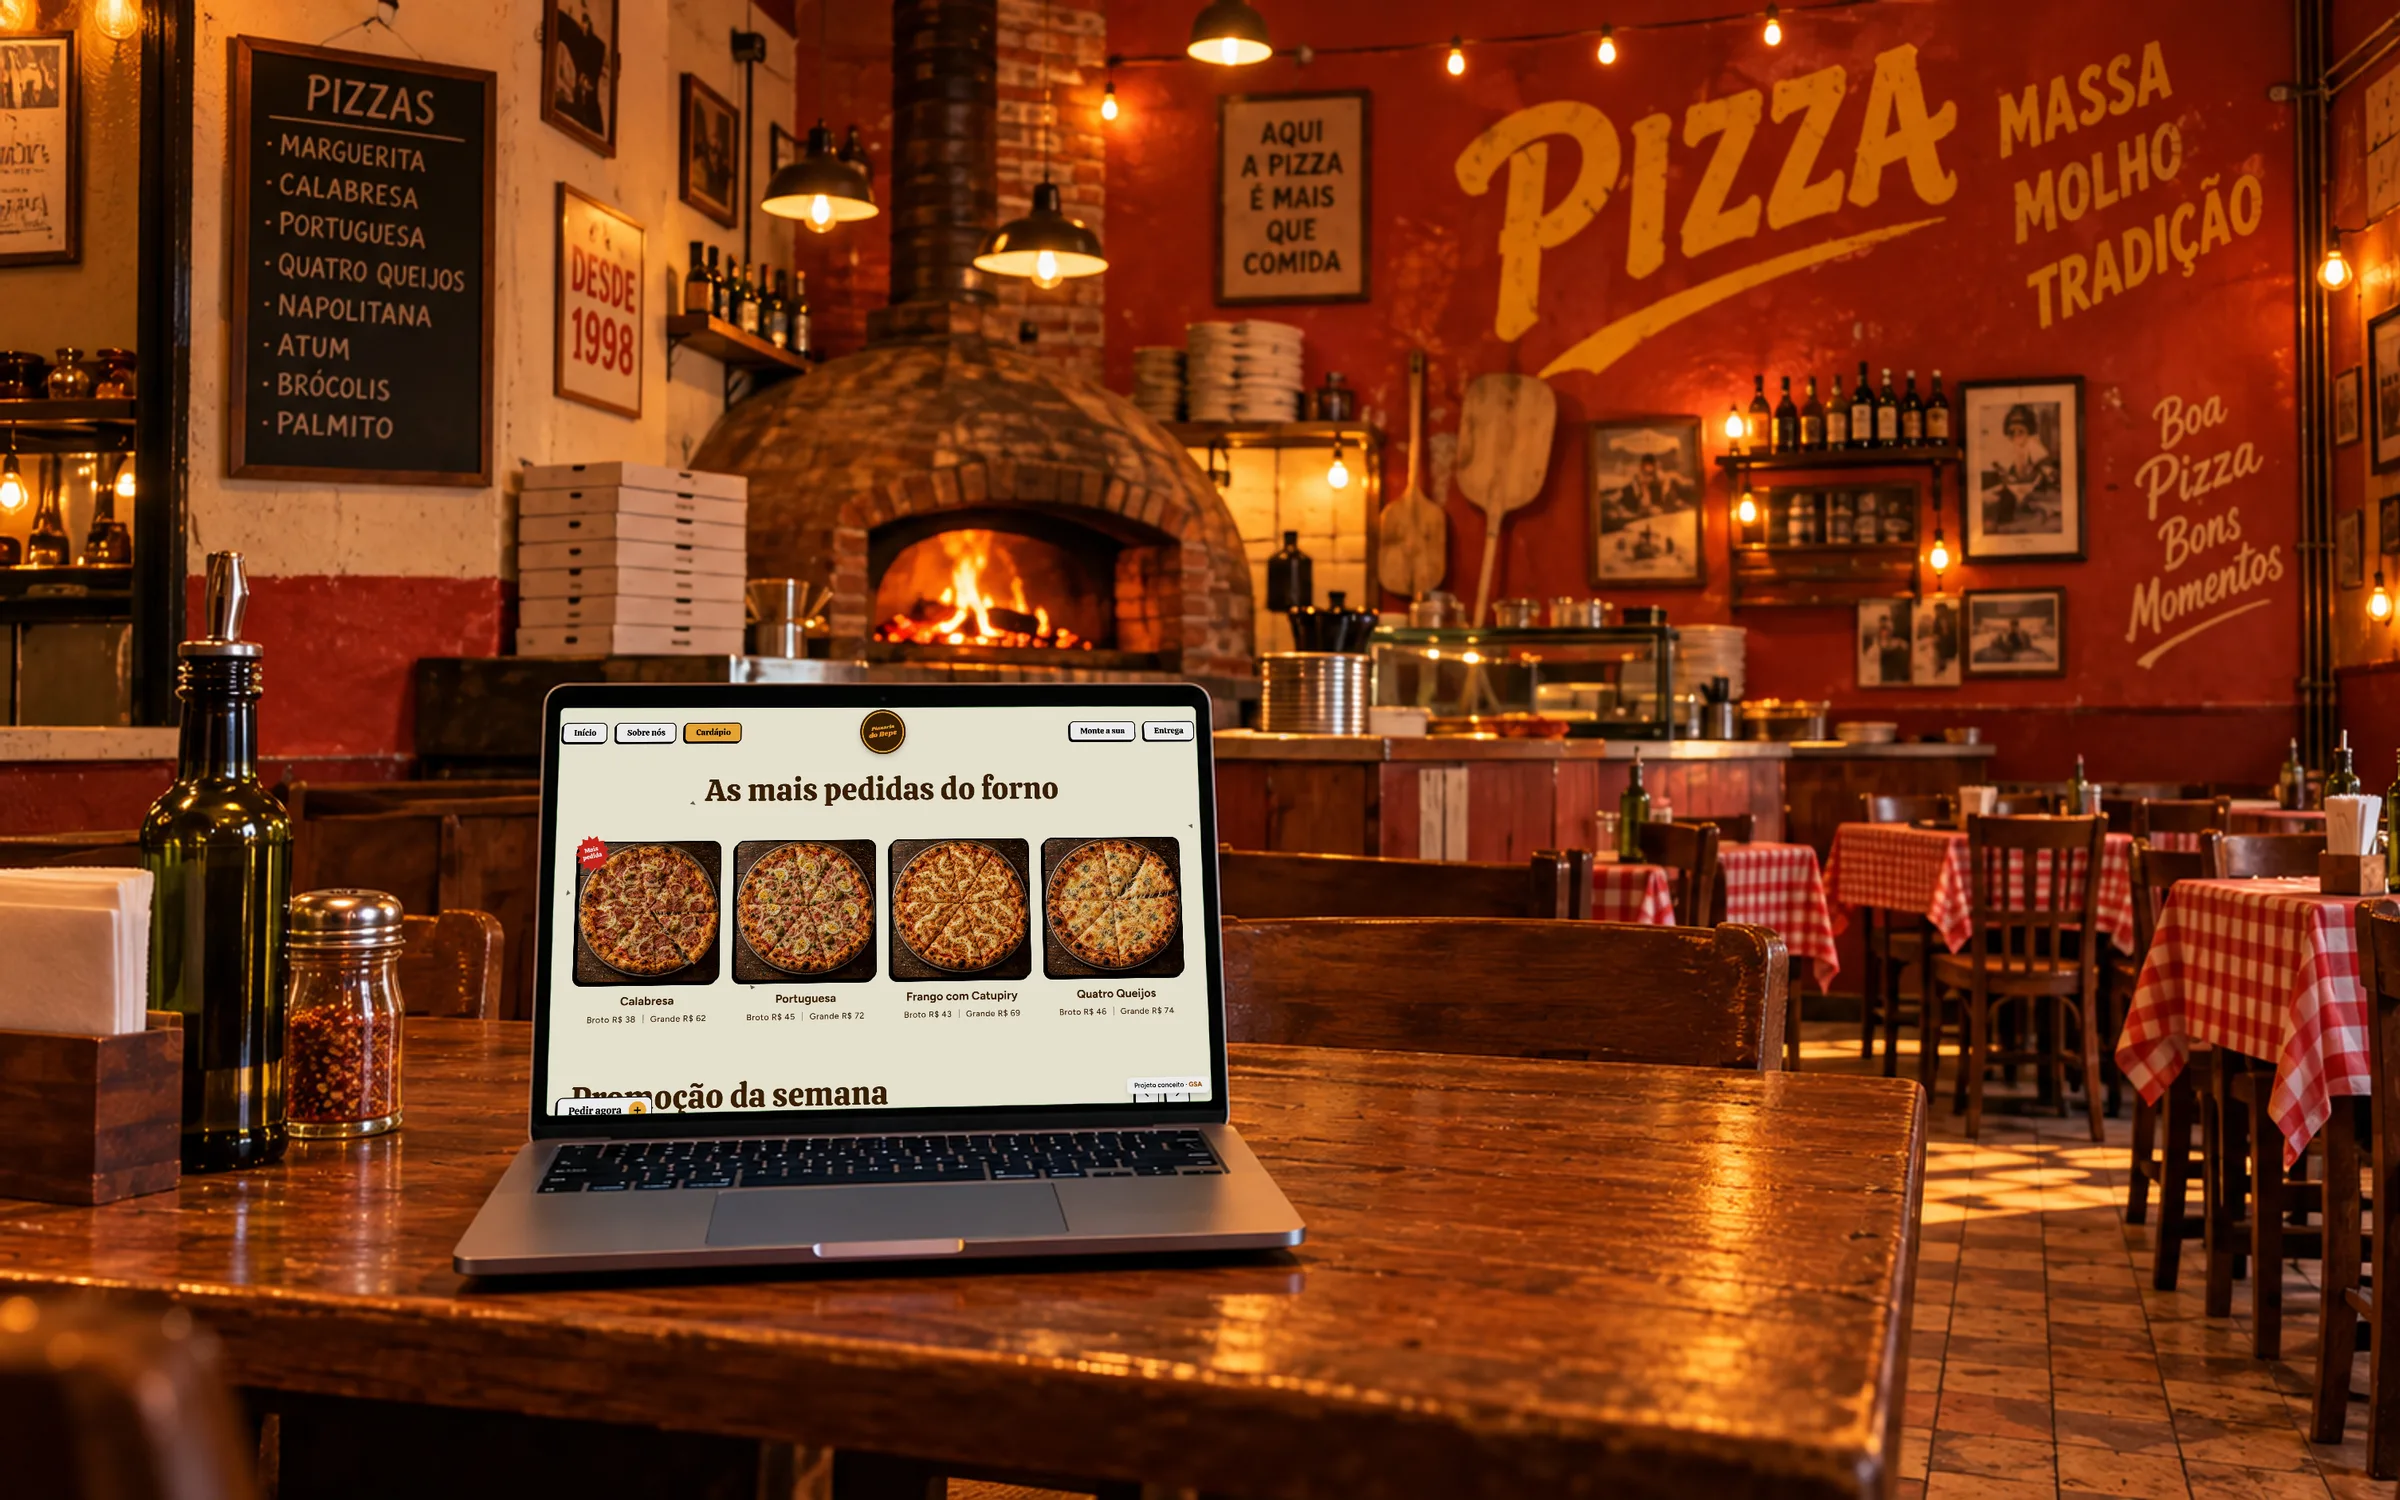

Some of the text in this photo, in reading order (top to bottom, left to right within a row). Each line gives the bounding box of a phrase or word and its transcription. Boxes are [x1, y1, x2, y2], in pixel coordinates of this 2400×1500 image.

[306, 73, 435, 126] PIZZAS
[1999, 40, 2173, 160] MASSA
[1261, 120, 1323, 147] AQUI
[279, 132, 426, 173] MARGUERITA
[1241, 152, 1343, 178] A PIZZA
[279, 172, 419, 210] CALABRESA
[1250, 183, 1335, 211] É MAIS
[1455, 42, 1957, 343] PIZZA
[2014, 122, 2182, 245] MOLHO
[279, 210, 426, 250] PORTUGUESA
[1266, 218, 1316, 245] QUE
[1243, 250, 1342, 275] COMIDA
[2026, 173, 2263, 330] TRADIÇÃO
[278, 252, 466, 294] QUATRO QUEIJOS
[572, 243, 636, 315] DESDE
[278, 292, 432, 329] NAPOLITANA
[277, 332, 350, 361] ATUM
[572, 306, 634, 376] 1998
[277, 367, 391, 401] BRÓCOLIS
[277, 410, 394, 440] PALMITO
[2152, 395, 2228, 450] Boa
[2134, 442, 2264, 521] Pizza
[2158, 506, 2241, 573] Bons
[2125, 541, 2284, 643] Momentos
[574, 728, 597, 737] Início
[627, 728, 666, 737] Sobre nós
[696, 727, 731, 738] Cardápio
[1080, 727, 1105, 735] Monte
[1154, 727, 1184, 736] Entrega
[704, 773, 1059, 807] As mais pedidas do forno
[620, 996, 674, 1007] Calabresa
[775, 993, 836, 1006] Portuguesa
[906, 990, 1018, 1003] Frango com Catupiry
[1077, 988, 1157, 1000] Quatro Queijos
[587, 1014, 707, 1024] Broto R$ 38 Grande R$ 62
[746, 1011, 865, 1022] Broto R$ 45 Grande R$ 72
[904, 1009, 1021, 1019] Broto R$ 43 Grande R$ 69
[1059, 1006, 1175, 1017] Broto R$ 46 Grande R$ 74
[730, 1081, 764, 1109] da
[773, 1085, 888, 1108] semana
[569, 1106, 622, 1115] Pedir agora
